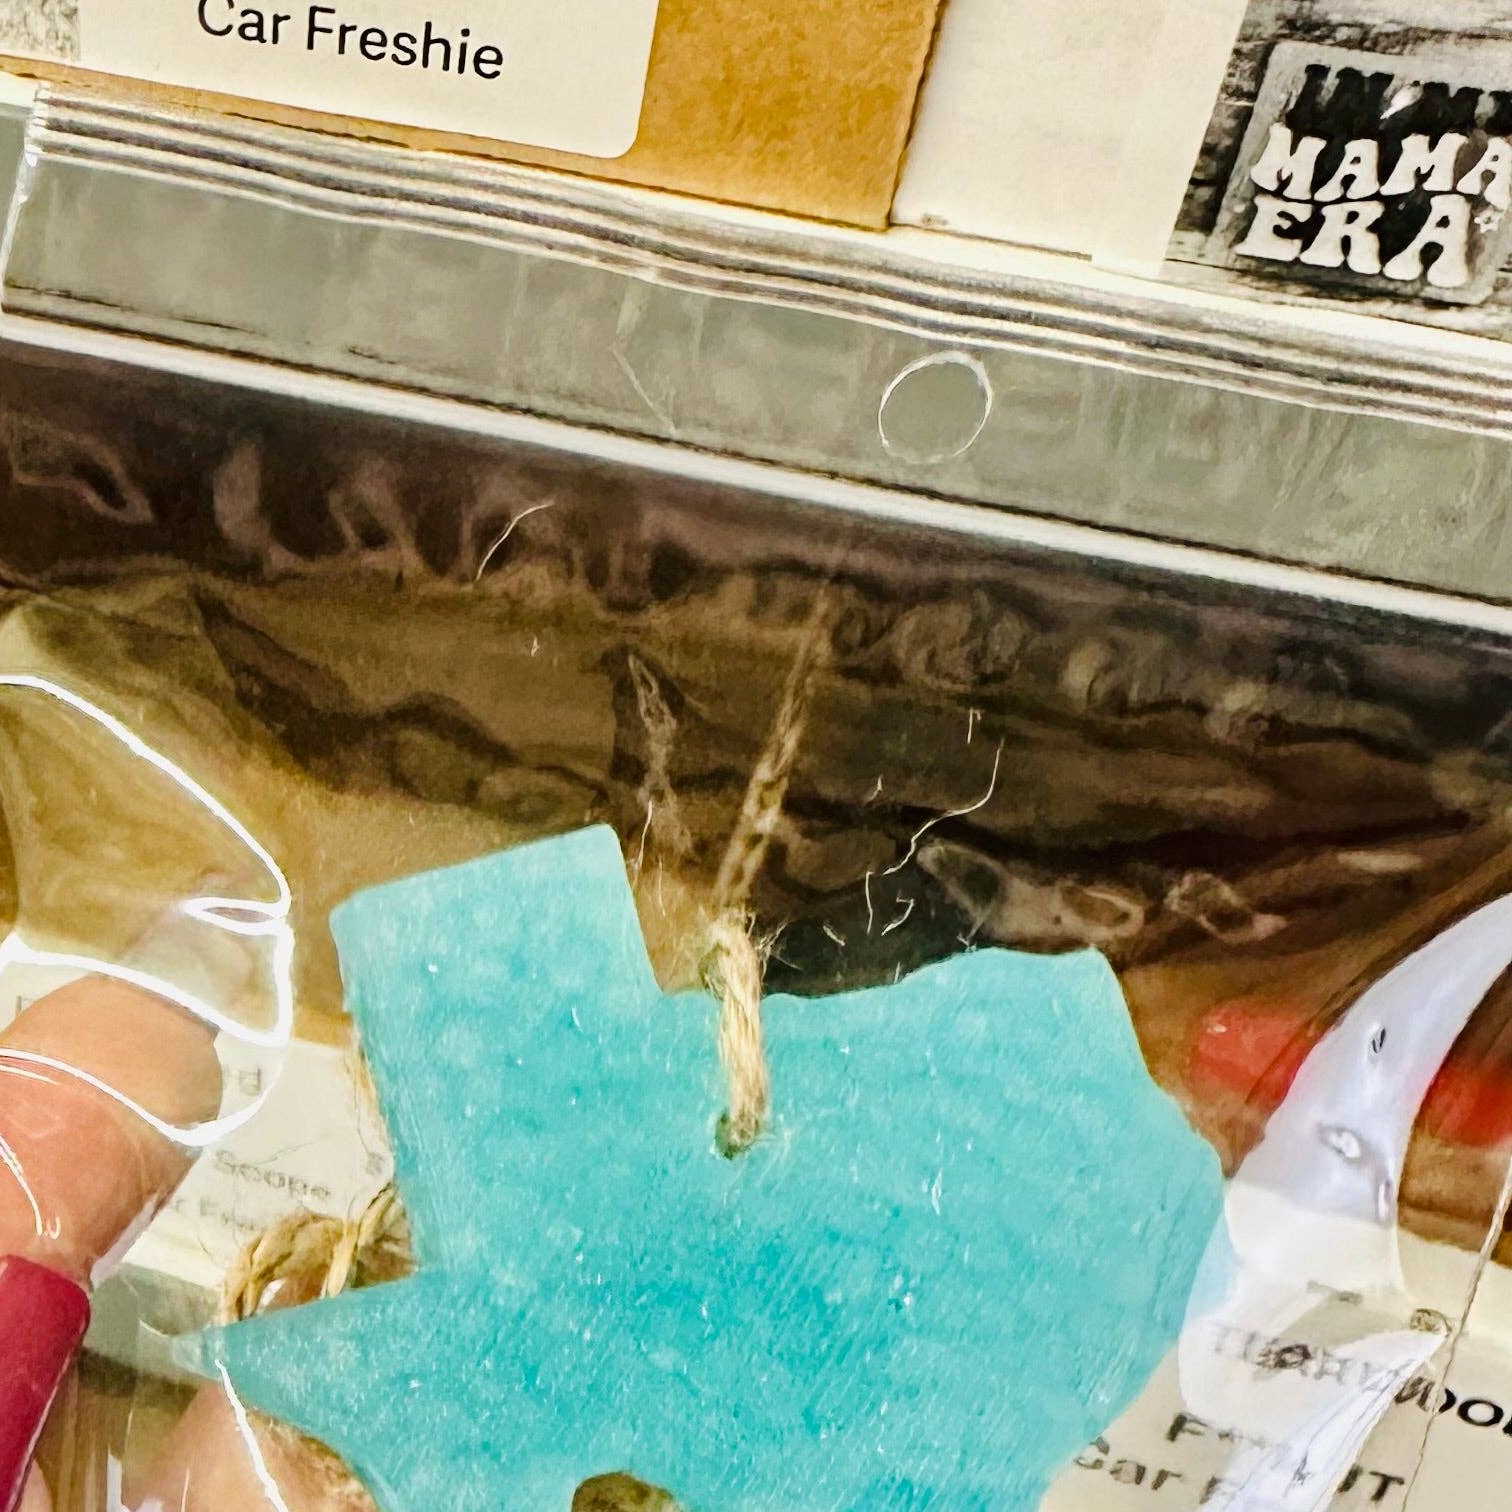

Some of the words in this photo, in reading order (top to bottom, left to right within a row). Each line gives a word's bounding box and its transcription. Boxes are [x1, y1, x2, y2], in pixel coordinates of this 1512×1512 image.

[198, 0, 291, 44] Car
[306, 5, 504, 80] Freshie
[1250, 122, 1512, 210] MAMA
[1232, 194, 1473, 288] ERA
